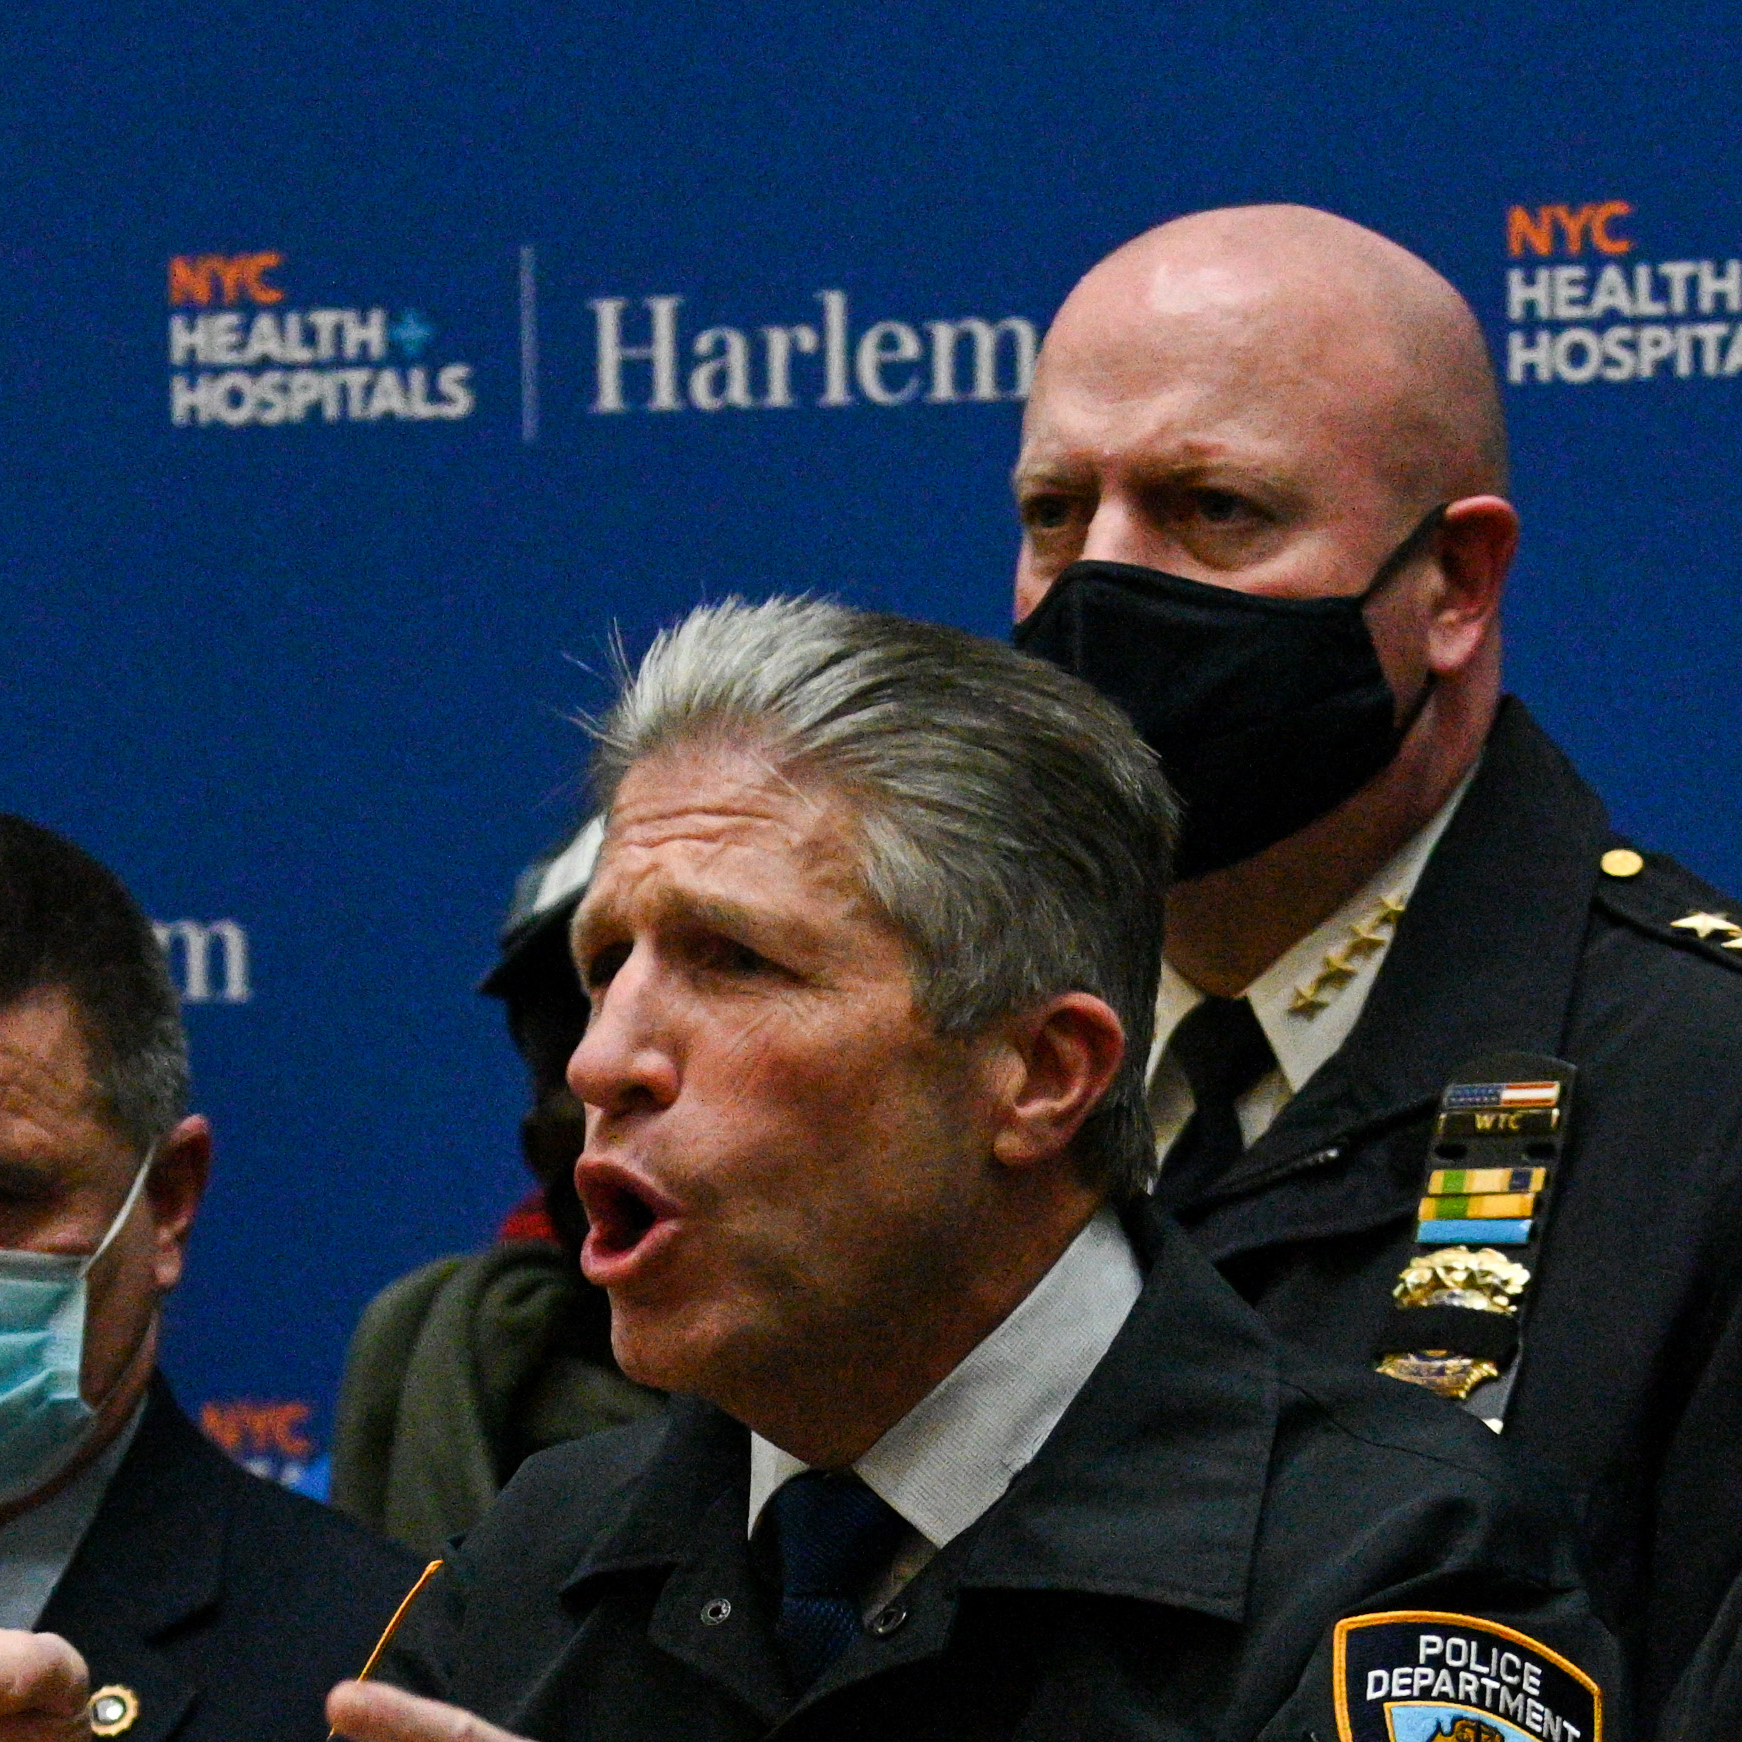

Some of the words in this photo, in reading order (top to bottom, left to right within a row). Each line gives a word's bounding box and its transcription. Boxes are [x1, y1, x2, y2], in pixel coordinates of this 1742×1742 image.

[1507, 201, 1632, 256] NYC
[168, 250, 284, 305] NYC
[588, 289, 1039, 414] Harlem
[170, 362, 475, 427] HOSPITALS
[1474, 1113, 1522, 1131] WTC
[1418, 1634, 1543, 1697] POLICE
